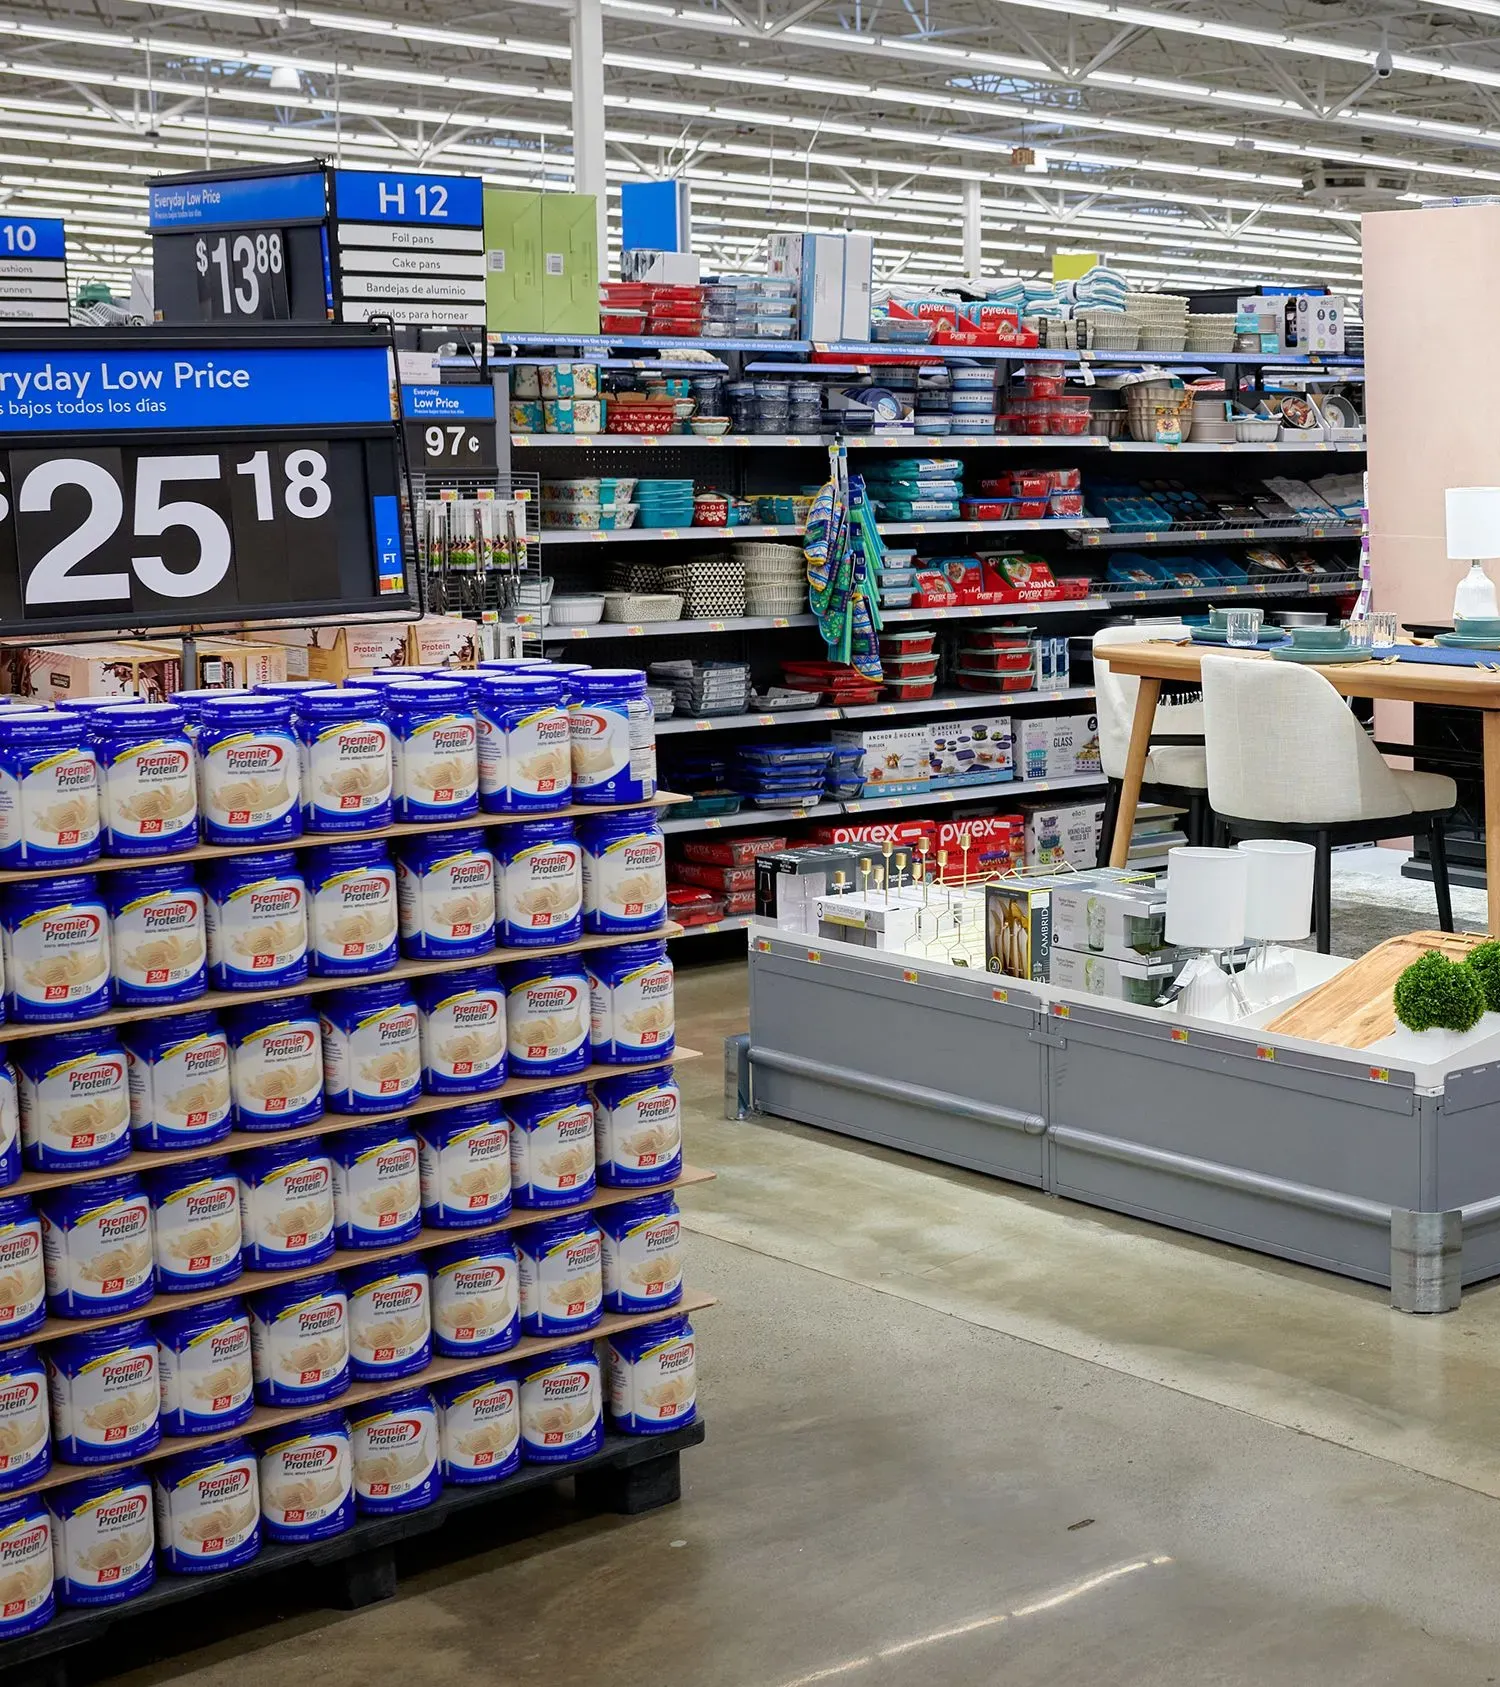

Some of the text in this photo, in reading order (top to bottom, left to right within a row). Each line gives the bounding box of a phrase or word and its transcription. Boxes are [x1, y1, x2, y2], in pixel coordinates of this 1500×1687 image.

[154, 189, 221, 211] Everyday Low Price
[379, 182, 448, 217] H 12
[3, 225, 37, 252] 10
[392, 232, 435, 246] Foil pans
[392, 258, 441, 270] Cake pans
[366, 282, 466, 296] Bandejas de aluminio
[919, 303, 946, 313] pyrex
[981, 306, 1007, 316] pyrex
[408, 311, 430, 321] para
[431, 309, 469, 320] hornear
[101, 363, 163, 390] Low
[174, 361, 251, 389] Price
[414, 388, 440, 397] Everyday
[9, 397, 167, 419] bajos todos los días
[414, 397, 460, 409] Low Price
[386, 537, 392, 546] 7
[382, 553, 397, 564] FT
[392, 577, 399, 587] 7
[1018, 589, 1043, 600] pyrex
[353, 643, 383, 655] Protein
[421, 642, 451, 652] Protein
[938, 723, 961, 731] ANCHOR
[938, 729, 963, 737] HOCKING
[338, 732, 378, 747] Premier
[868, 731, 925, 741] ANCHOR HOCKING
[341, 742, 377, 754] Protein
[1053, 737, 1073, 748] GLASS
[226, 747, 271, 760] Premier
[228, 756, 268, 768] Protein
[56, 761, 93, 779] Premier
[58, 774, 91, 786] Protein
[231, 811, 249, 821] 30g
[834, 824, 899, 844] pyrex
[939, 818, 995, 847] pyrex
[742, 840, 775, 854] pyrex
[529, 854, 568, 867] Premier
[532, 863, 566, 874] Protein
[143, 904, 188, 919] Premier
[815, 902, 824, 918] 3
[146, 914, 185, 927] Protein
[534, 914, 550, 923] 30g
[42, 918, 90, 933] Premier
[45, 928, 87, 941] Protein
[149, 971, 167, 981] 30g
[49, 986, 67, 997] 30g
[526, 989, 566, 1002] Premier
[528, 998, 564, 1009] Protein
[454, 1269, 495, 1282] Premier
[456, 1278, 494, 1290] Protein
[458, 1328, 474, 1337] 30g
[108, 1427, 124, 1438] 30g
[367, 1423, 409, 1437] Premier
[369, 1433, 407, 1445] Protein
[282, 1449, 326, 1463] Premier
[284, 1458, 323, 1470] Protein
[371, 1484, 387, 1493] 30g
[96, 1499, 140, 1518] Premier
[99, 1511, 138, 1526] Protein
[206, 1540, 222, 1549] 30g
